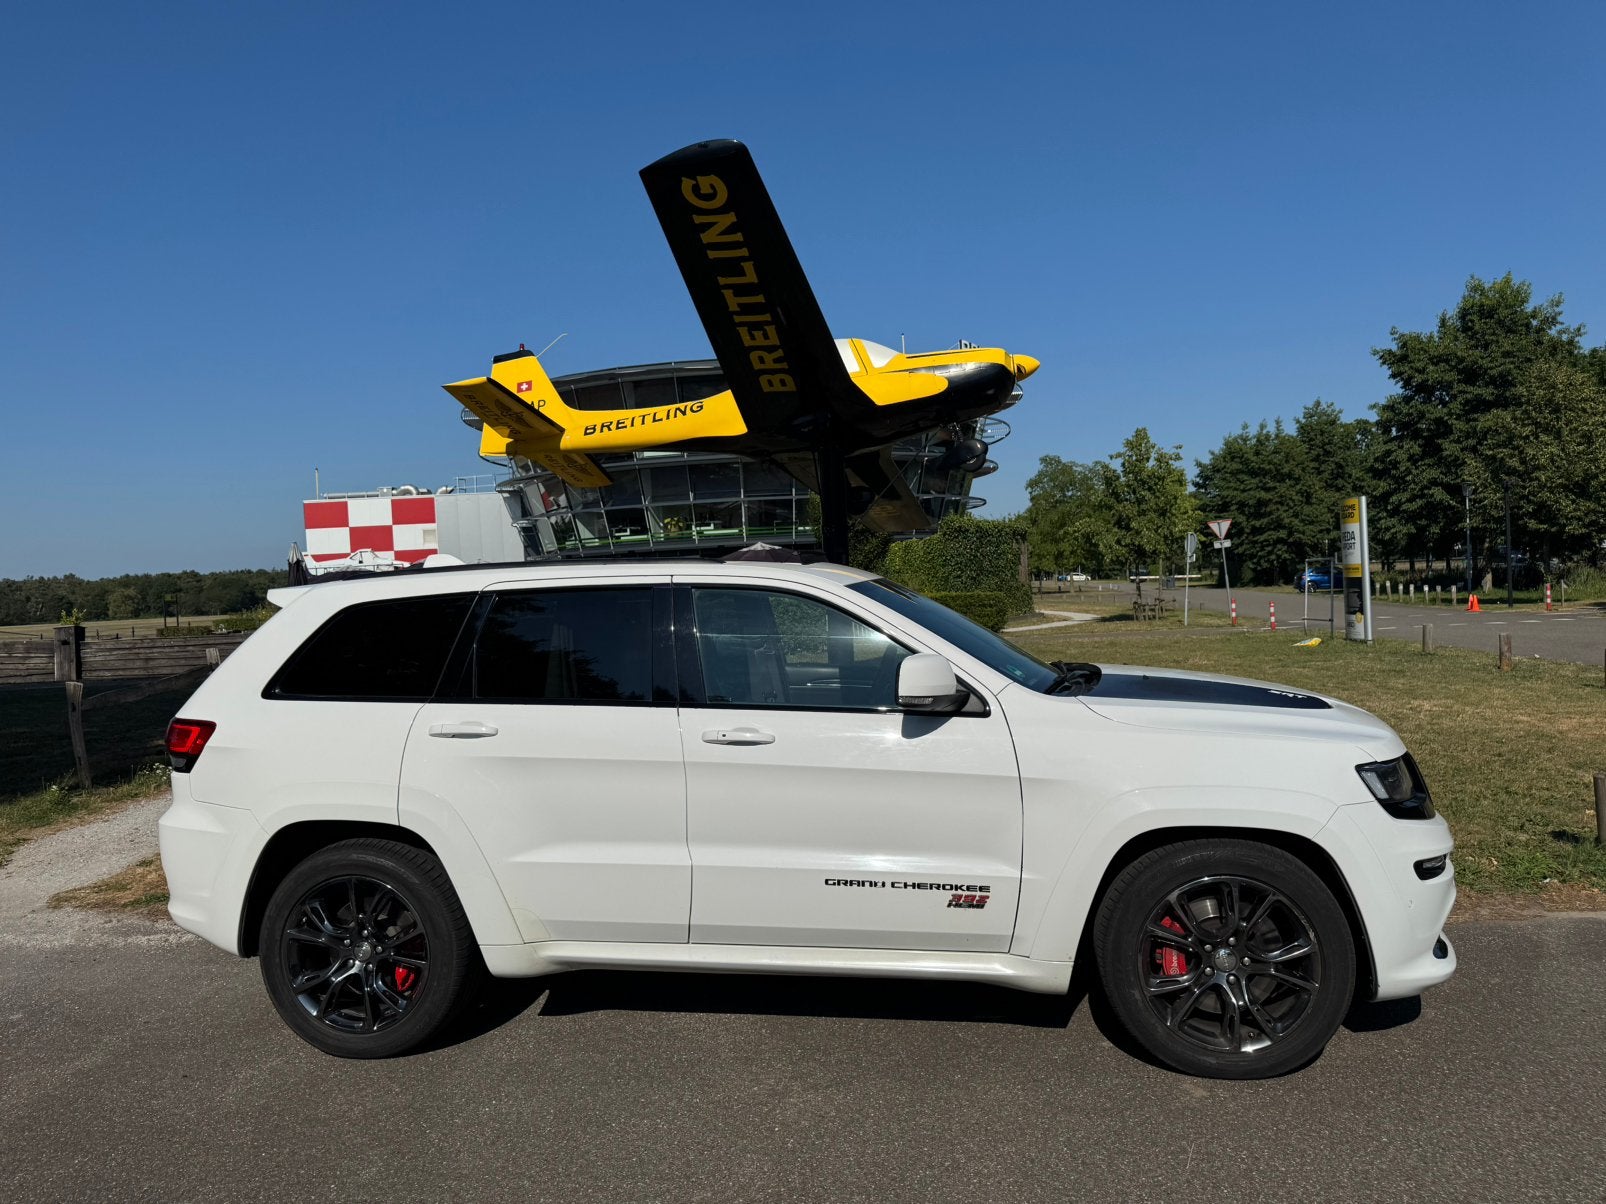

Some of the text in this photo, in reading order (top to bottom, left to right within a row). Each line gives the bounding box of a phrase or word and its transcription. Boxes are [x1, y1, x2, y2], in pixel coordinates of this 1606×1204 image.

[681, 174, 797, 393] BREITLING
[583, 401, 704, 436] BREITLING
[824, 878, 991, 893] GRAND CHEROKEE
